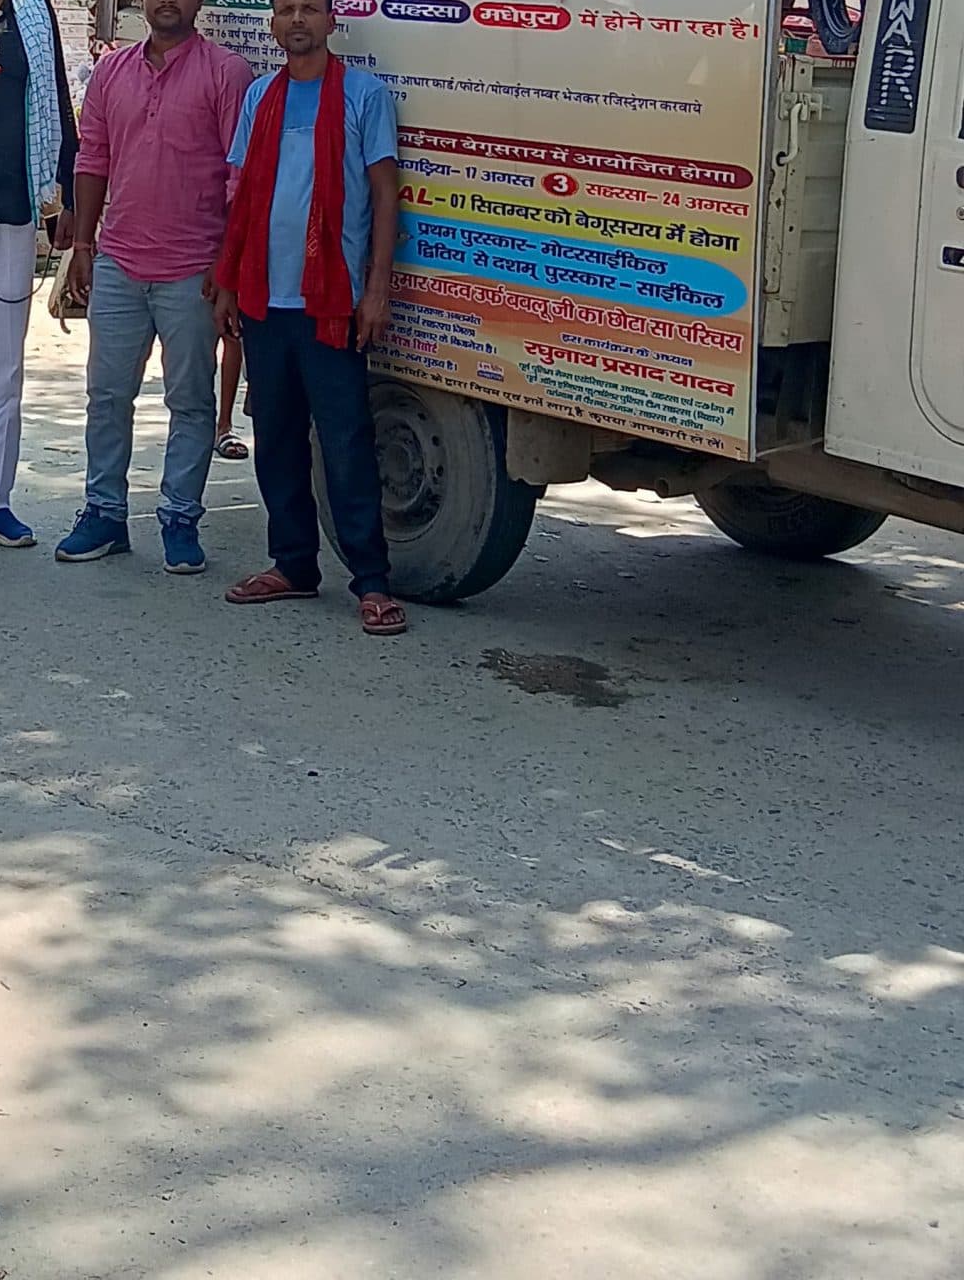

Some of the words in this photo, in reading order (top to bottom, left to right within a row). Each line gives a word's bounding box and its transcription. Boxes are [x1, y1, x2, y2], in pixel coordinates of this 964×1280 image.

[386, 1, 463, 19] सहरसा
[479, 5, 561, 28] मधेपुरा
[579, 9, 598, 28] में
[604, 12, 644, 31] होने
[650, 18, 682, 33] जा
[687, 20, 725, 38] रहा
[533, 87, 559, 100] नम्बर
[562, 88, 600, 104] भेजकर
[659, 99, 703, 115] करवाये
[460, 136, 547, 158] बेगूसराय
[550, 148, 569, 163] में
[573, 153, 675, 176] आयोजित
[465, 166, 477, 179] 17
[480, 170, 535, 188] अगस्त
[552, 175, 569, 193] 3
[663, 192, 680, 207] 24
[684, 197, 749, 217] अगस्त
[450, 193, 466, 209] 07
[471, 193, 541, 221] सितम्बर
[545, 207, 571, 226] को
[575, 210, 662, 238] बेगूसराय
[666, 224, 686, 243] में
[689, 227, 740, 252] होगा
[417, 222, 456, 239] प्रथम
[541, 240, 668, 274] मोटरसाईकिल
[473, 250, 489, 266] से
[492, 256, 539, 280] दशम्
[544, 264, 617, 290] पुरस्कार
[637, 281, 725, 309] साईकिल
[430, 277, 472, 300] यादव
[474, 284, 504, 306] उर्फ
[506, 293, 552, 322] बबलू
[552, 296, 574, 319] जी
[577, 306, 603, 326] का
[606, 308, 647, 334] छोटा
[649, 319, 674, 339] सा
[677, 322, 743, 352] परिचय
[524, 340, 599, 366] रघुनाथ
[602, 356, 667, 382] प्रसाद
[669, 371, 735, 397] यादव
